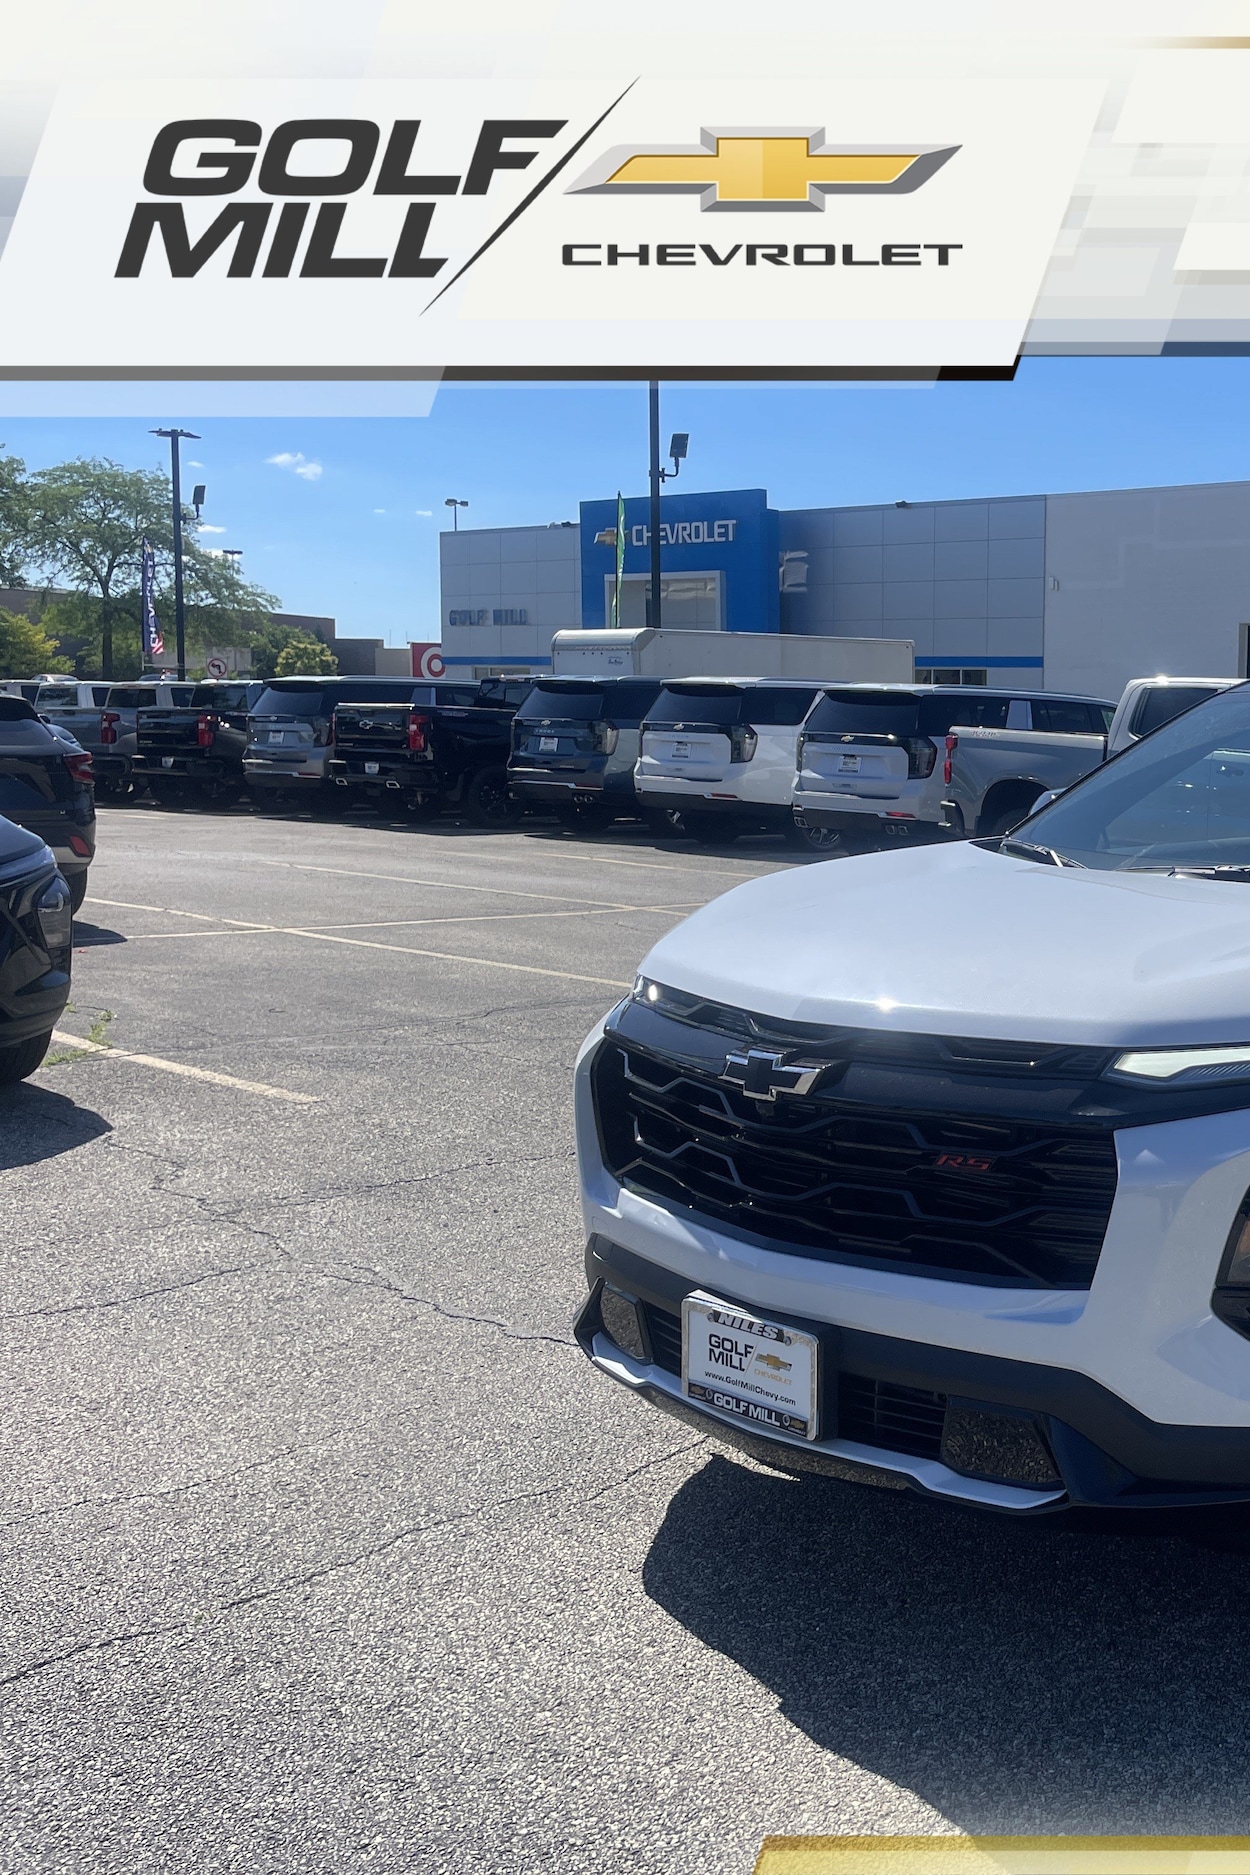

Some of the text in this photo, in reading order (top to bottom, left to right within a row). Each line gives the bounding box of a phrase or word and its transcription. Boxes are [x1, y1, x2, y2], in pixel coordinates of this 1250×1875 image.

[936, 1154, 990, 1170] RS
[717, 1311, 779, 1340] NILES
[708, 1333, 755, 1358] GOLF
[708, 1347, 746, 1372] MILL
[704, 1370, 796, 1406] www.GolfMillChevy.com
[713, 1392, 781, 1426] GOLF MILL
